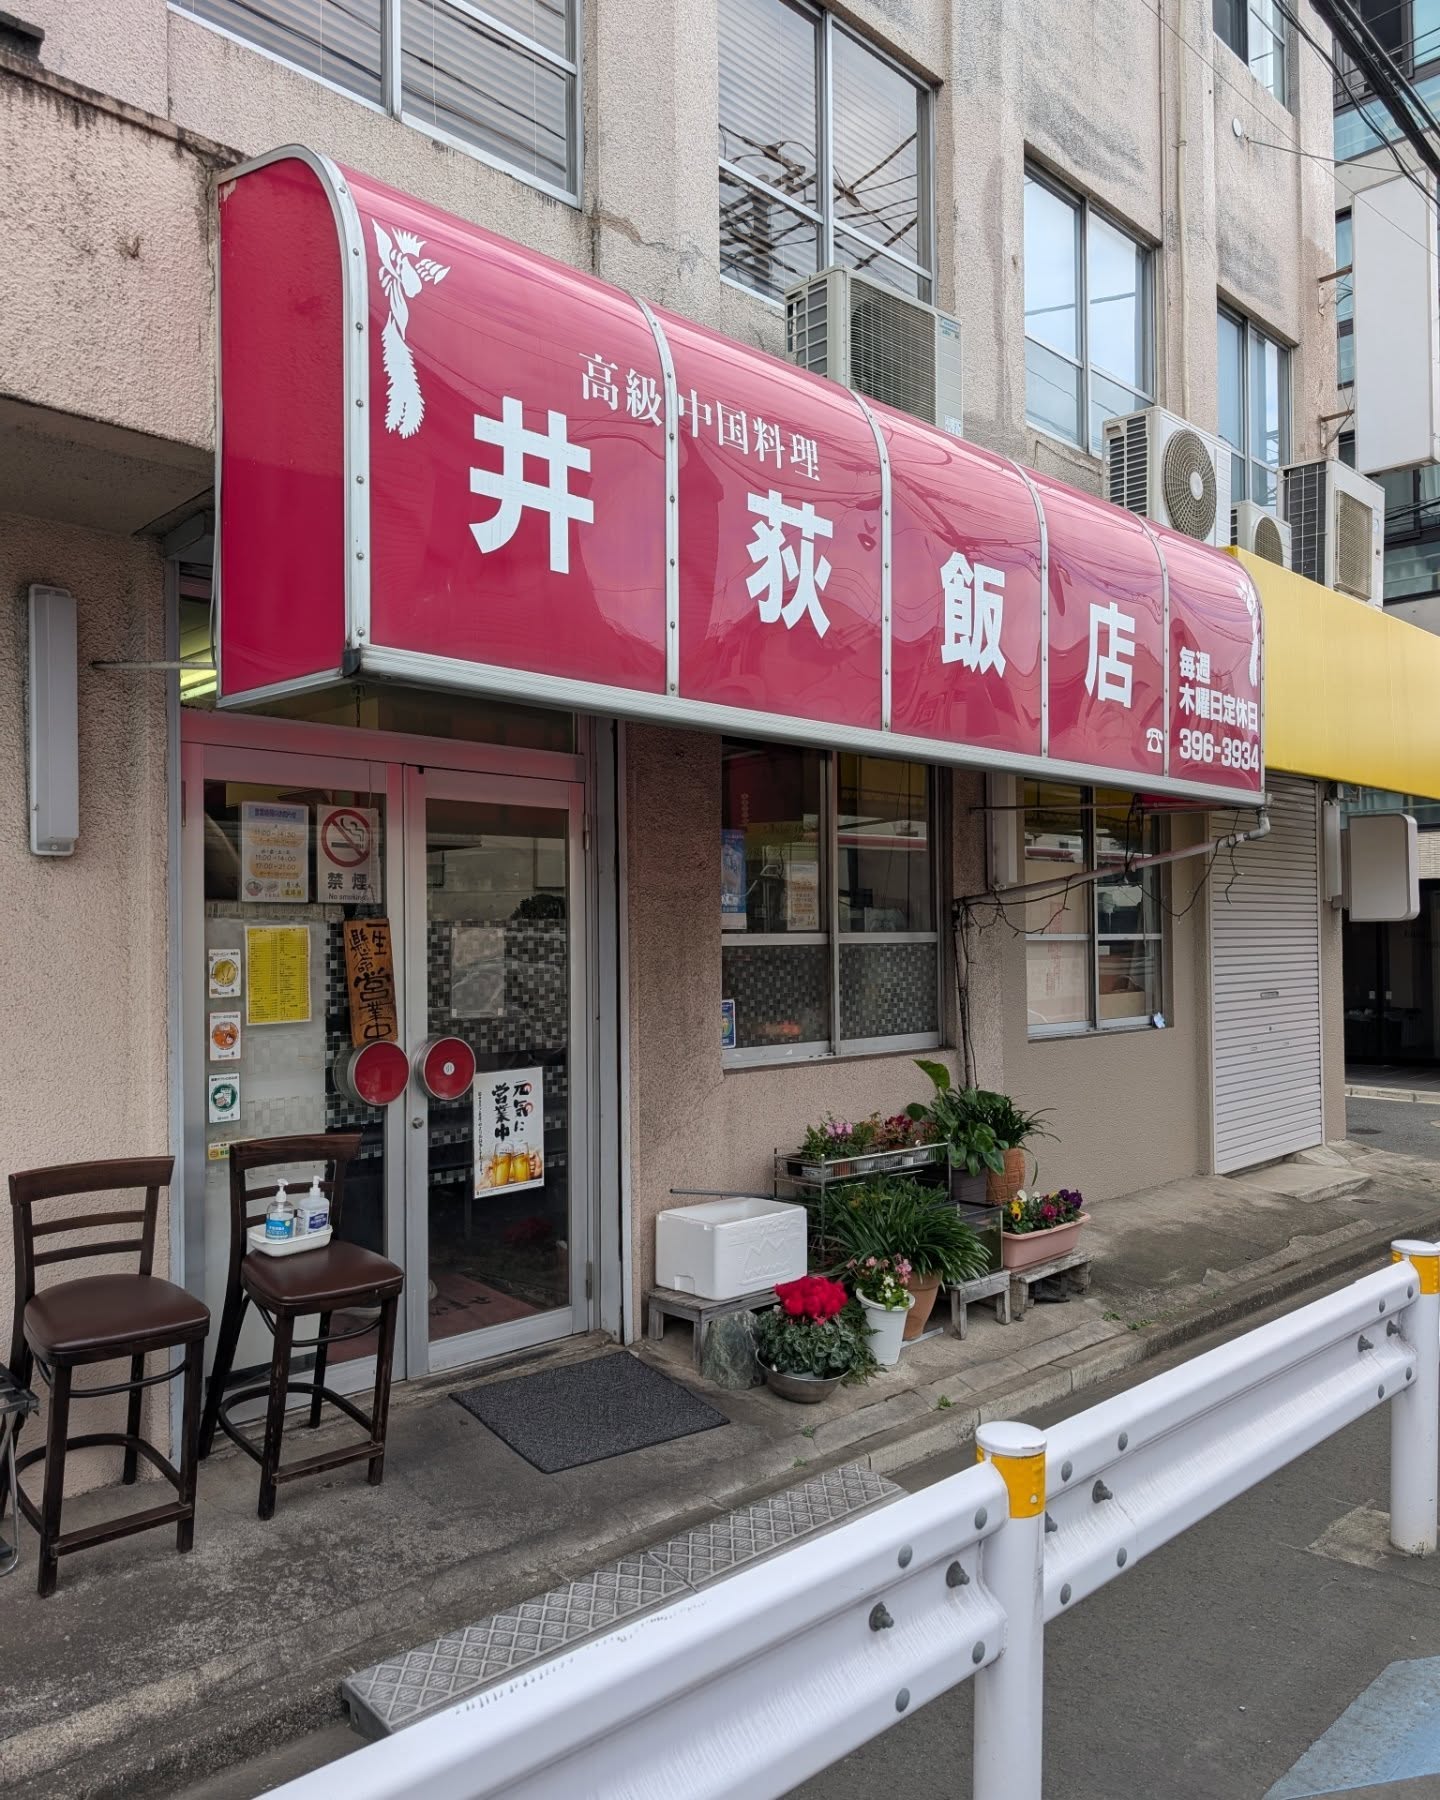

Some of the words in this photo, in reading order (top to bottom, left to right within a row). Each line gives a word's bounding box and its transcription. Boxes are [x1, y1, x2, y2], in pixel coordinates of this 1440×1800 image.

[578, 352, 821, 482] 高級中国料理
[468, 395, 1136, 709] 井荻飯店
[1179, 646, 1211, 685] 毎週
[1178, 682, 1258, 732] 木曜日定休日
[1179, 727, 1260, 773] 396-3934
[328, 892, 339, 901] No
[353, 967, 394, 1040] 営業中
[491, 1082, 511, 1142] 営業中
[512, 1080, 531, 1133] 元気に
